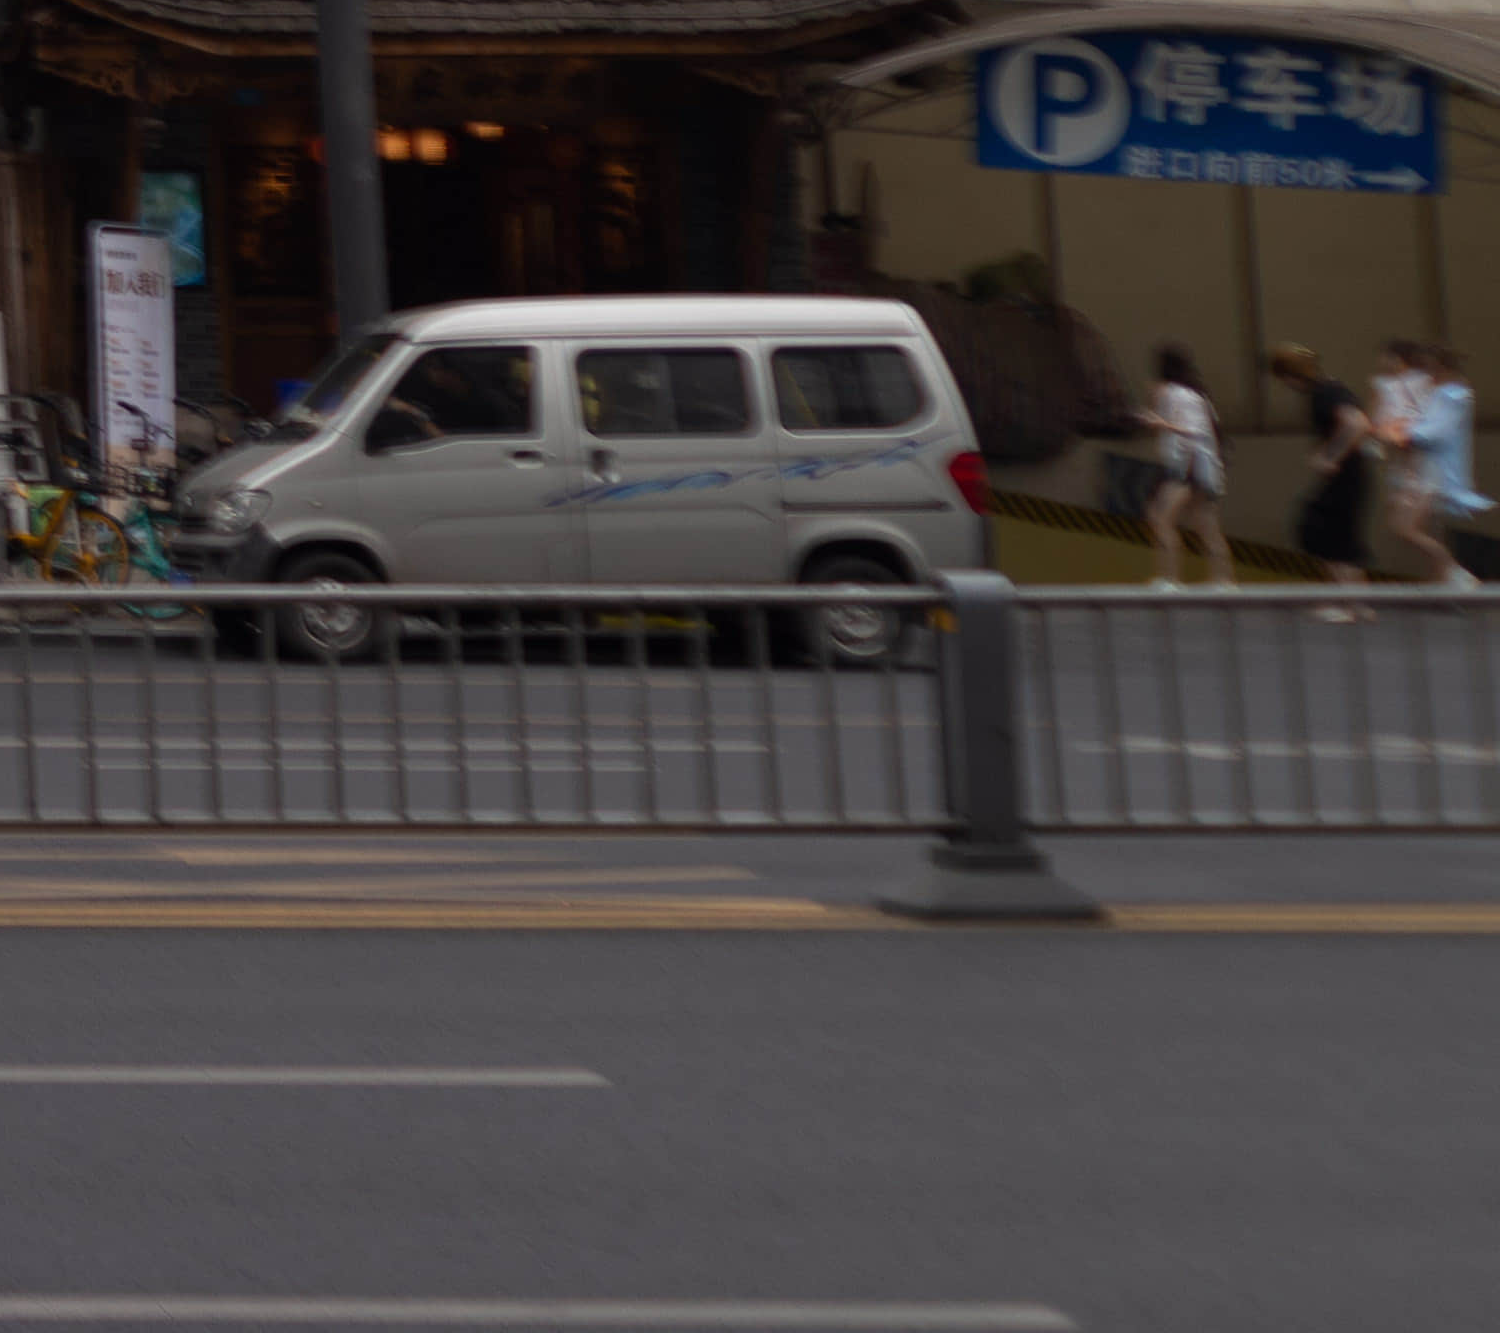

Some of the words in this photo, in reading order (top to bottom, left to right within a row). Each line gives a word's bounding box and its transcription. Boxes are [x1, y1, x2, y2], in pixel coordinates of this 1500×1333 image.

[1033, 54, 1096, 153] P
[1130, 38, 1426, 137] 停车场
[1121, 143, 1357, 192] 进口向前50米
